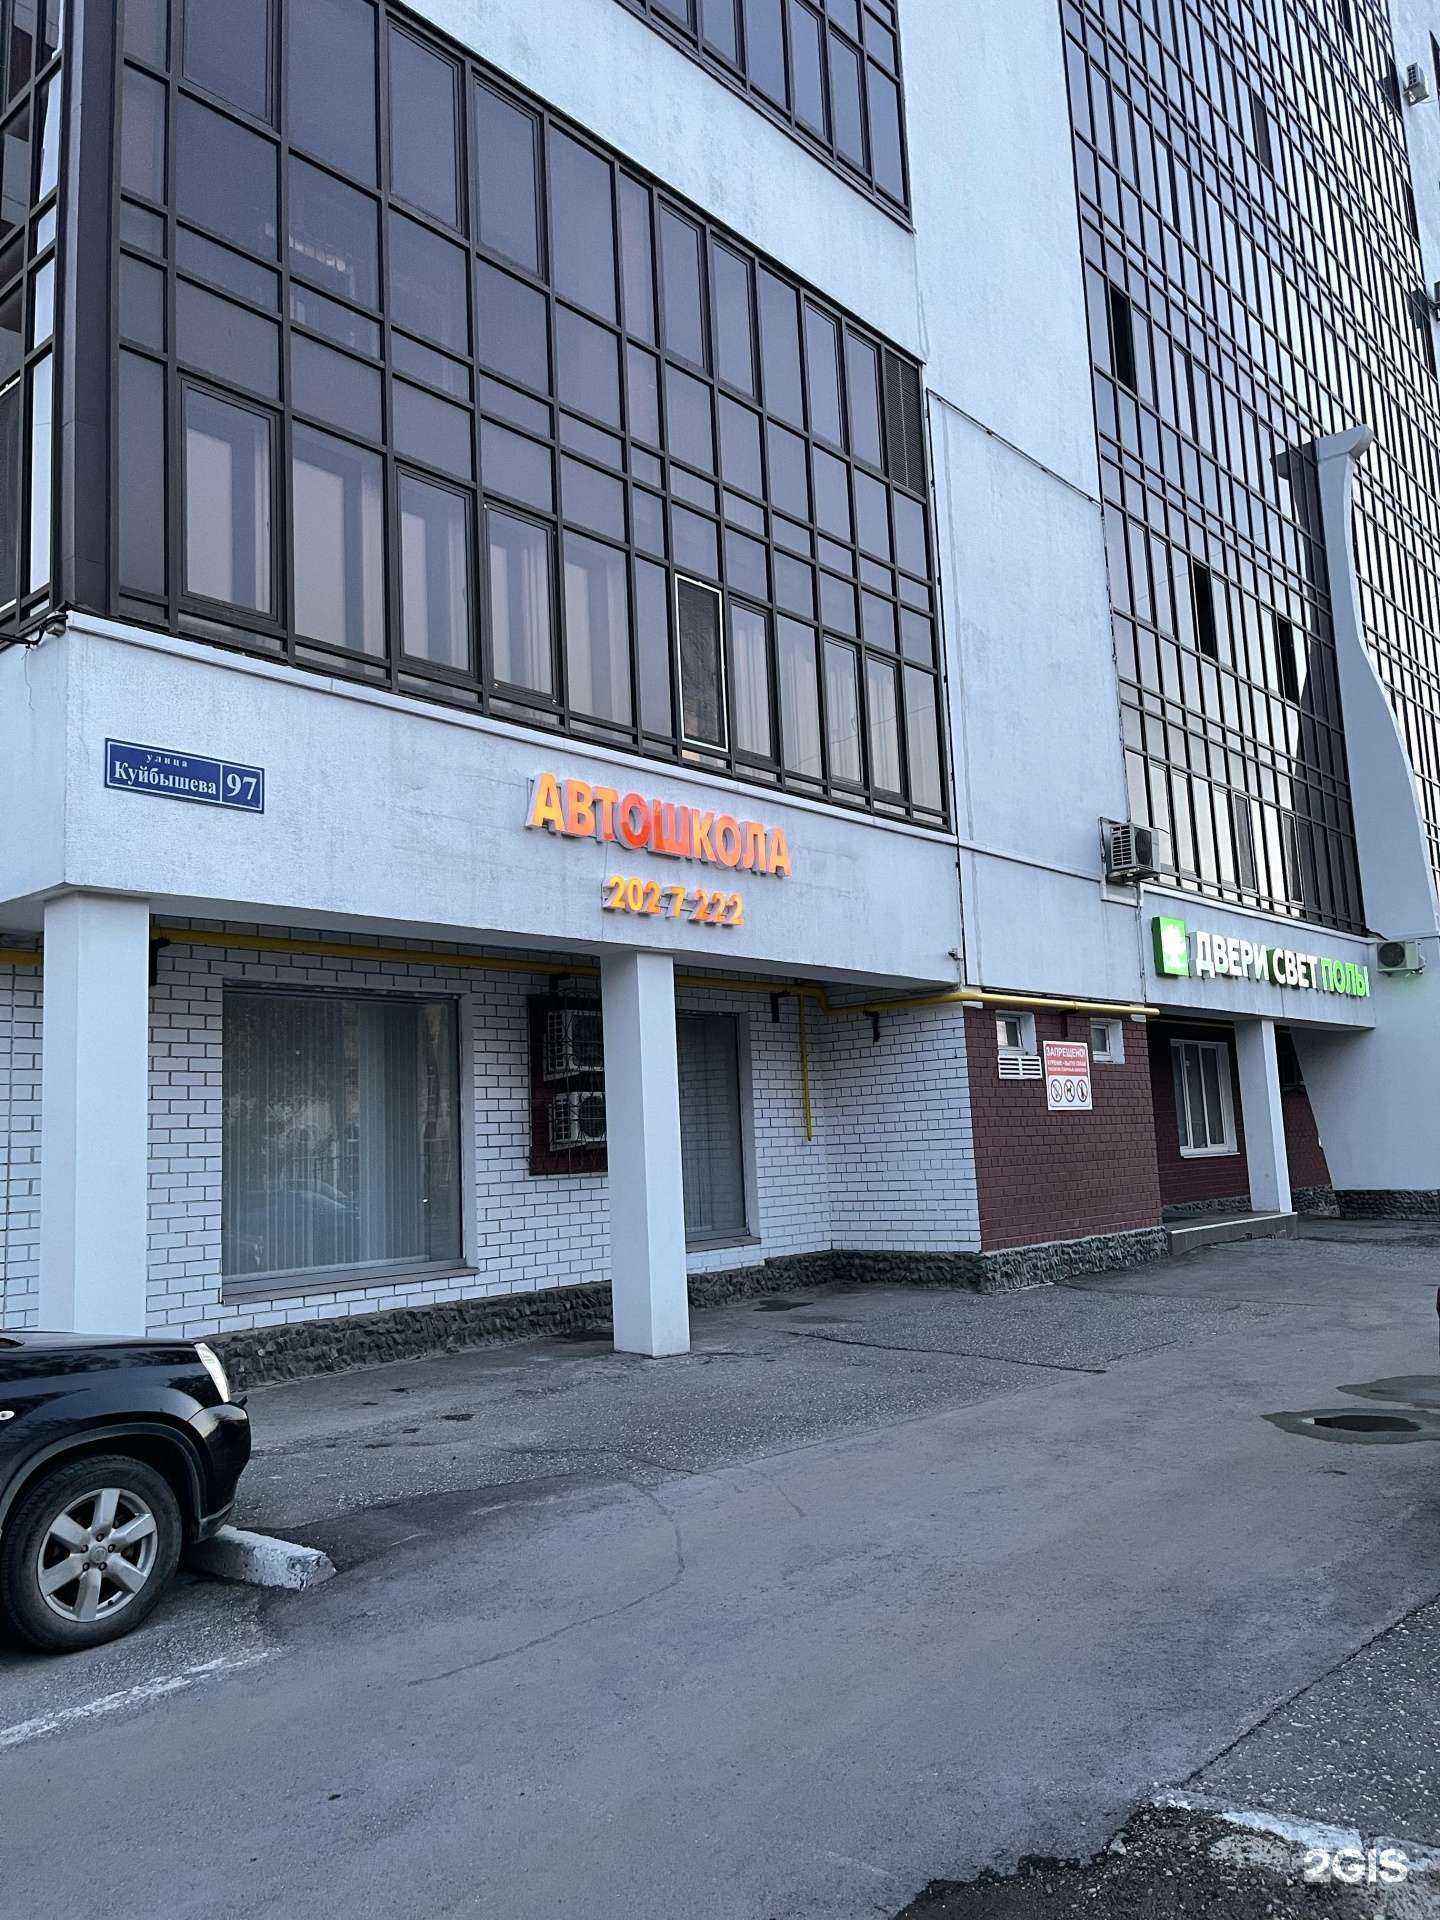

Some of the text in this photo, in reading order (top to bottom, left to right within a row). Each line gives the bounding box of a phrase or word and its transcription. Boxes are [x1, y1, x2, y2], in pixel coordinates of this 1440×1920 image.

[114, 761, 257, 800] Куйбышева 97
[145, 753, 188, 767] улица
[526, 772, 793, 878] АВТОШКОЛА
[1195, 930, 1371, 997] ДВЕРИ СВЕТ ПОЛЫ
